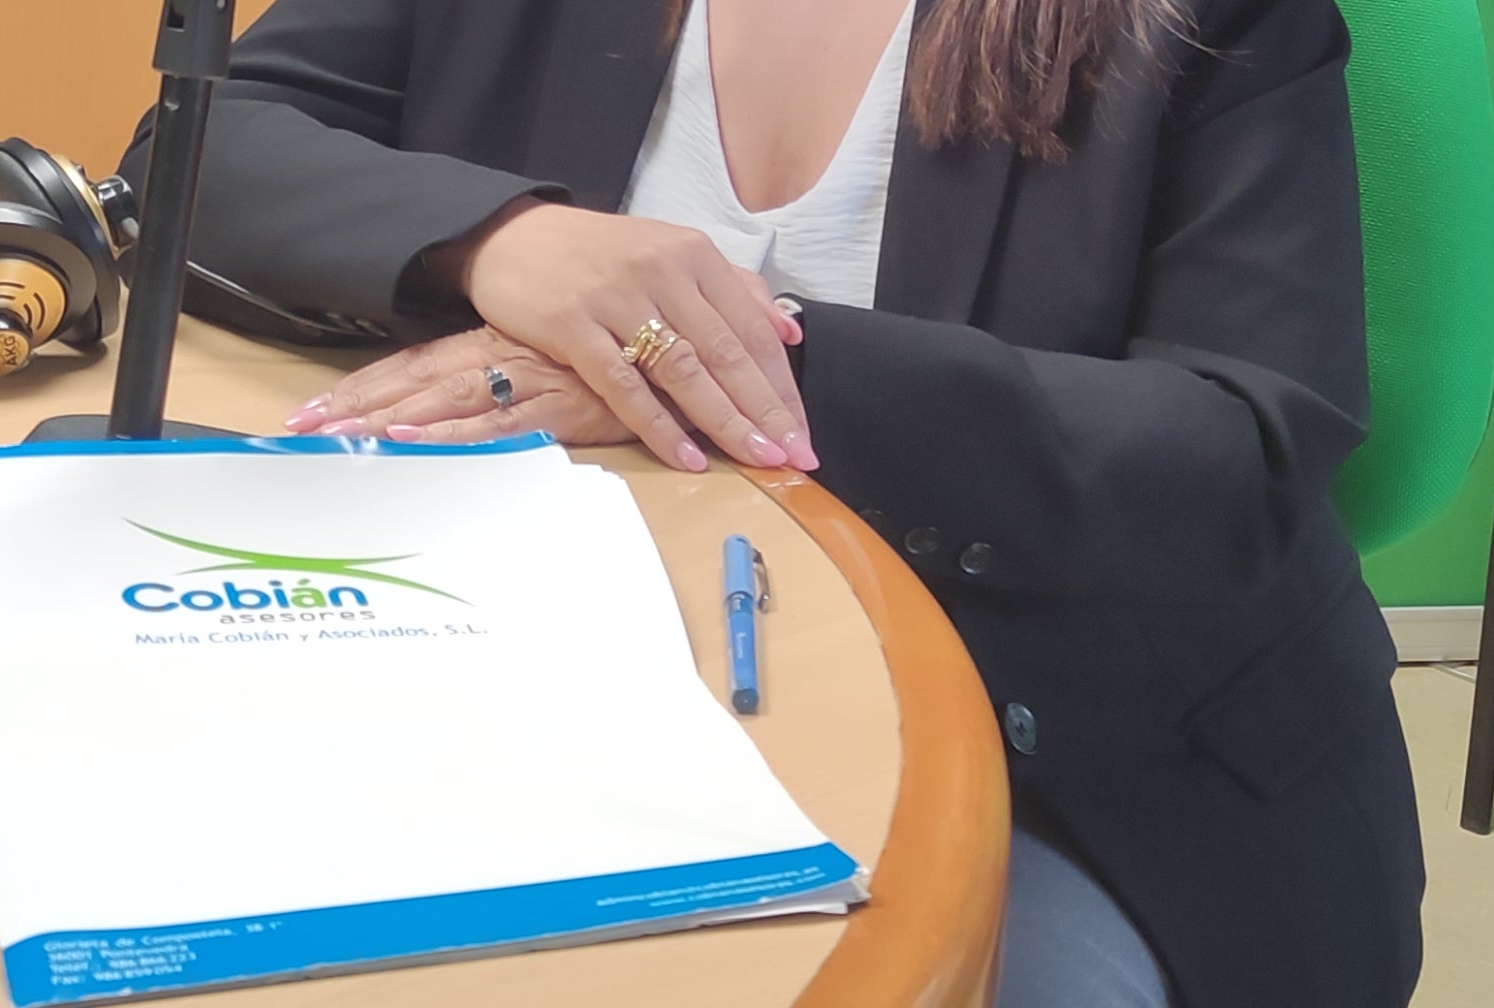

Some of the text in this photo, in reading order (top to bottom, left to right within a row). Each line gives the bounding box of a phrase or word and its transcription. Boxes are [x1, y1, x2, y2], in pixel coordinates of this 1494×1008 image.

[4, 336, 18, 365] AKG
[122, 578, 368, 612] Cobián
[219, 609, 376, 625] asesores
[135, 624, 488, 645] María Cobián y Asociados, S.L.
